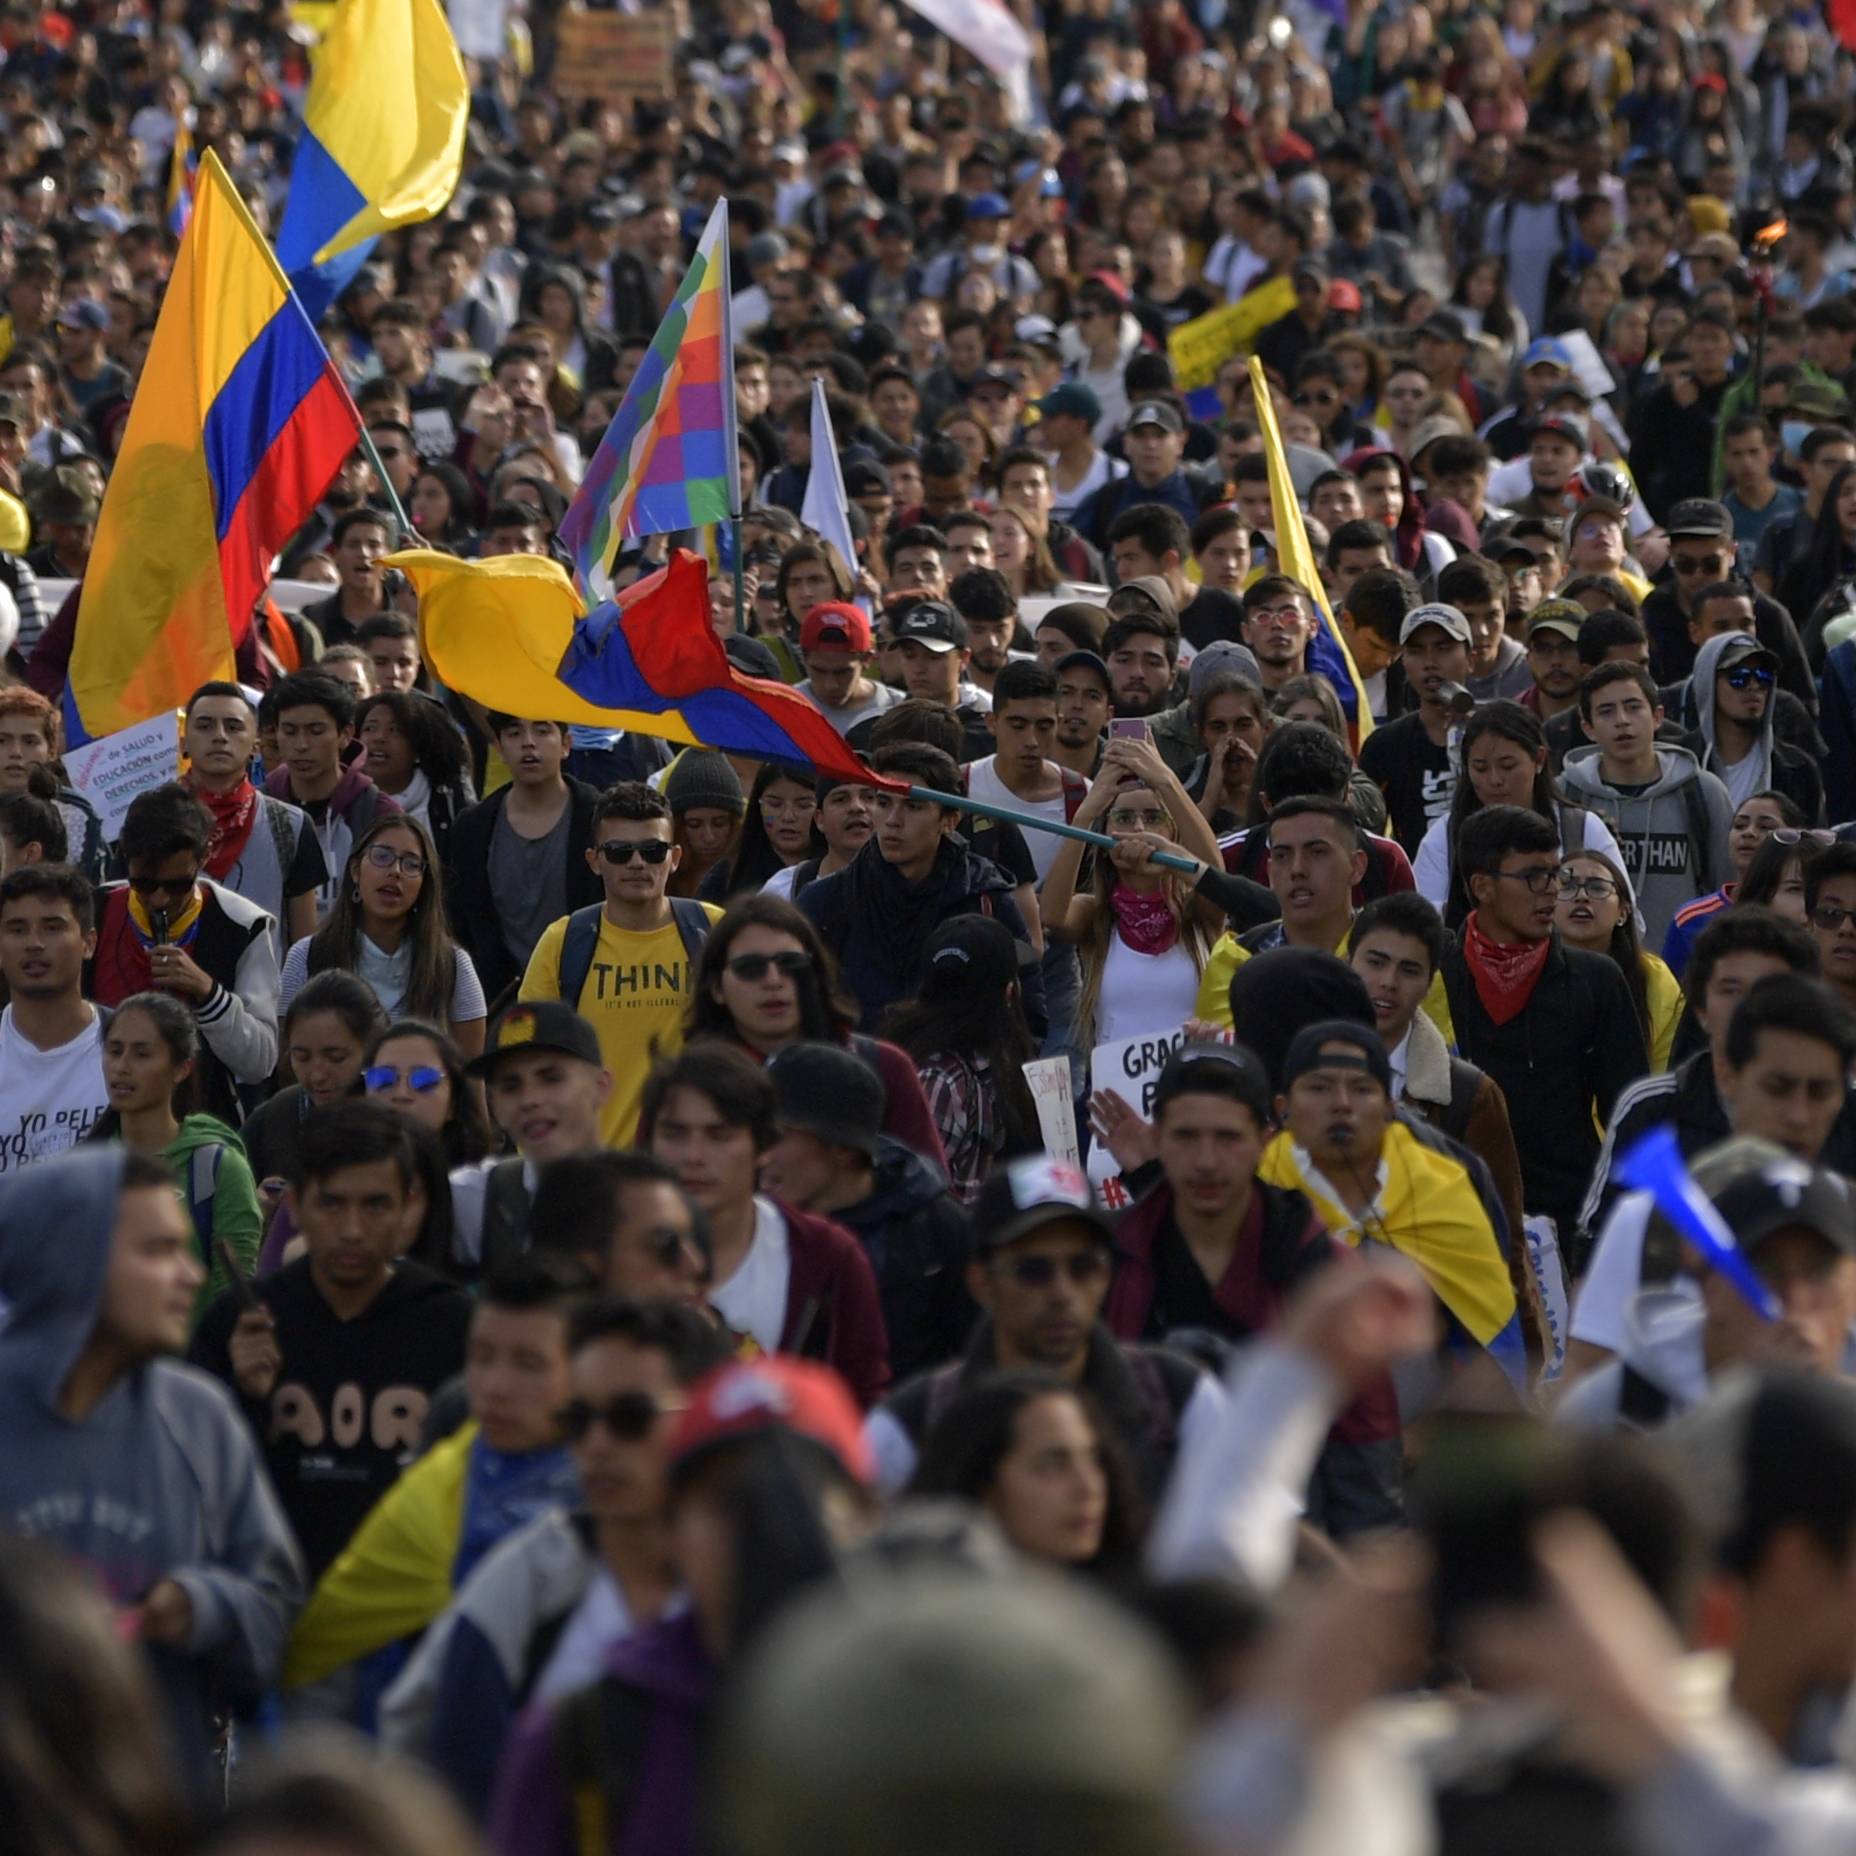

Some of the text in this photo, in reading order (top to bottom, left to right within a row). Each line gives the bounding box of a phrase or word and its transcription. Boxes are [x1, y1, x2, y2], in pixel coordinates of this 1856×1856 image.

[122, 734, 155, 754] SALUD
[92, 753, 152, 787] EDUCACIÓN
[1638, 839, 1688, 867] THAN
[19, 1113, 47, 1135] YO
[269, 1381, 432, 1451] AIR
